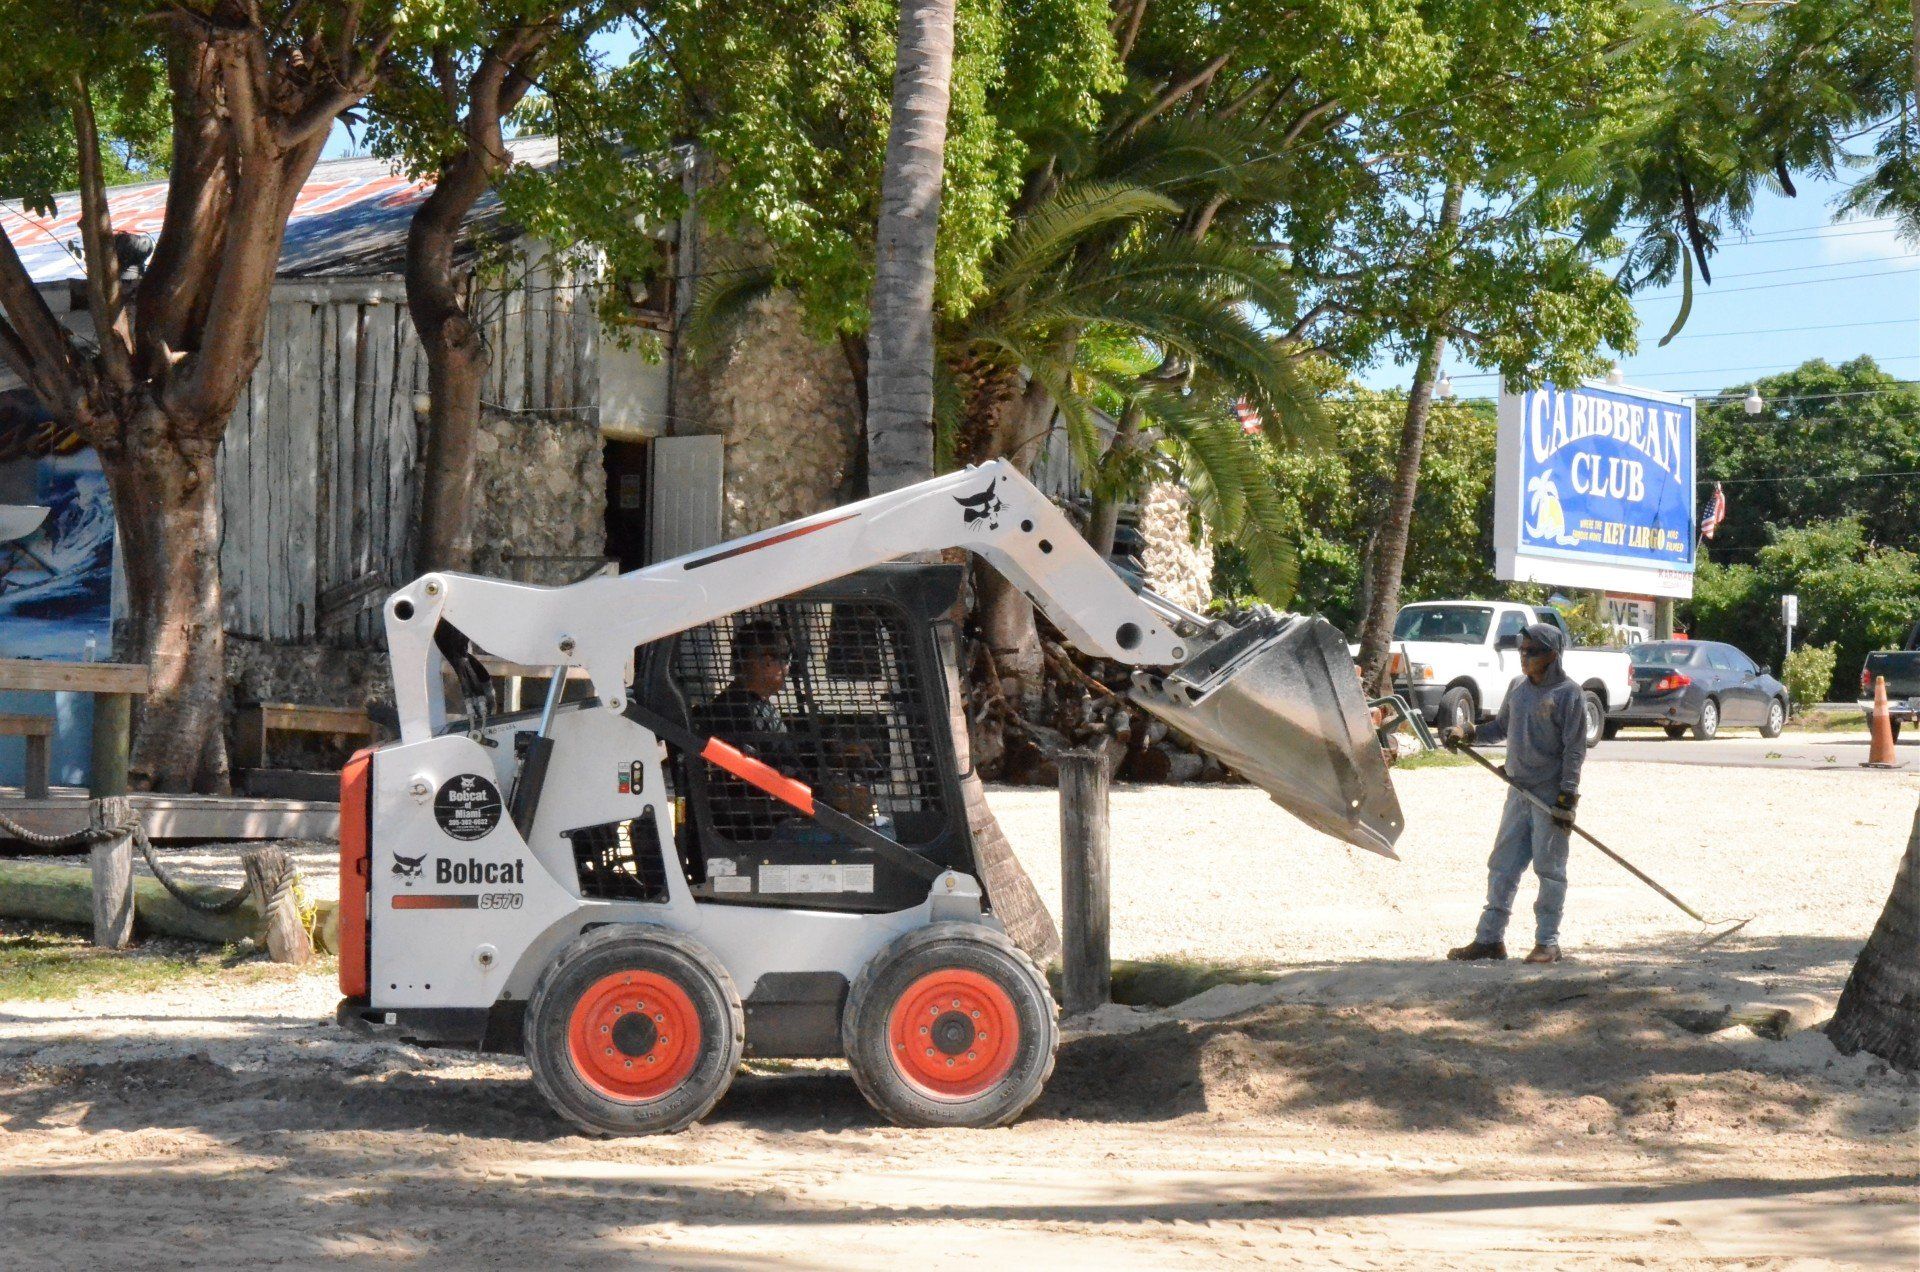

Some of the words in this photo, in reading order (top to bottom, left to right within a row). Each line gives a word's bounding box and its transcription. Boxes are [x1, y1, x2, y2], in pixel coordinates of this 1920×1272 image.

[1531, 389, 1682, 485] CARIBBEAN
[1571, 451, 1645, 502] CLUB
[1602, 521, 1627, 546] KEY
[1628, 525, 1666, 550] LARGO
[449, 790, 488, 801] Bobcat
[464, 801, 472, 809] of
[455, 809, 481, 819] Miami
[436, 857, 524, 884] Bobcat
[481, 893, 524, 910] S570
